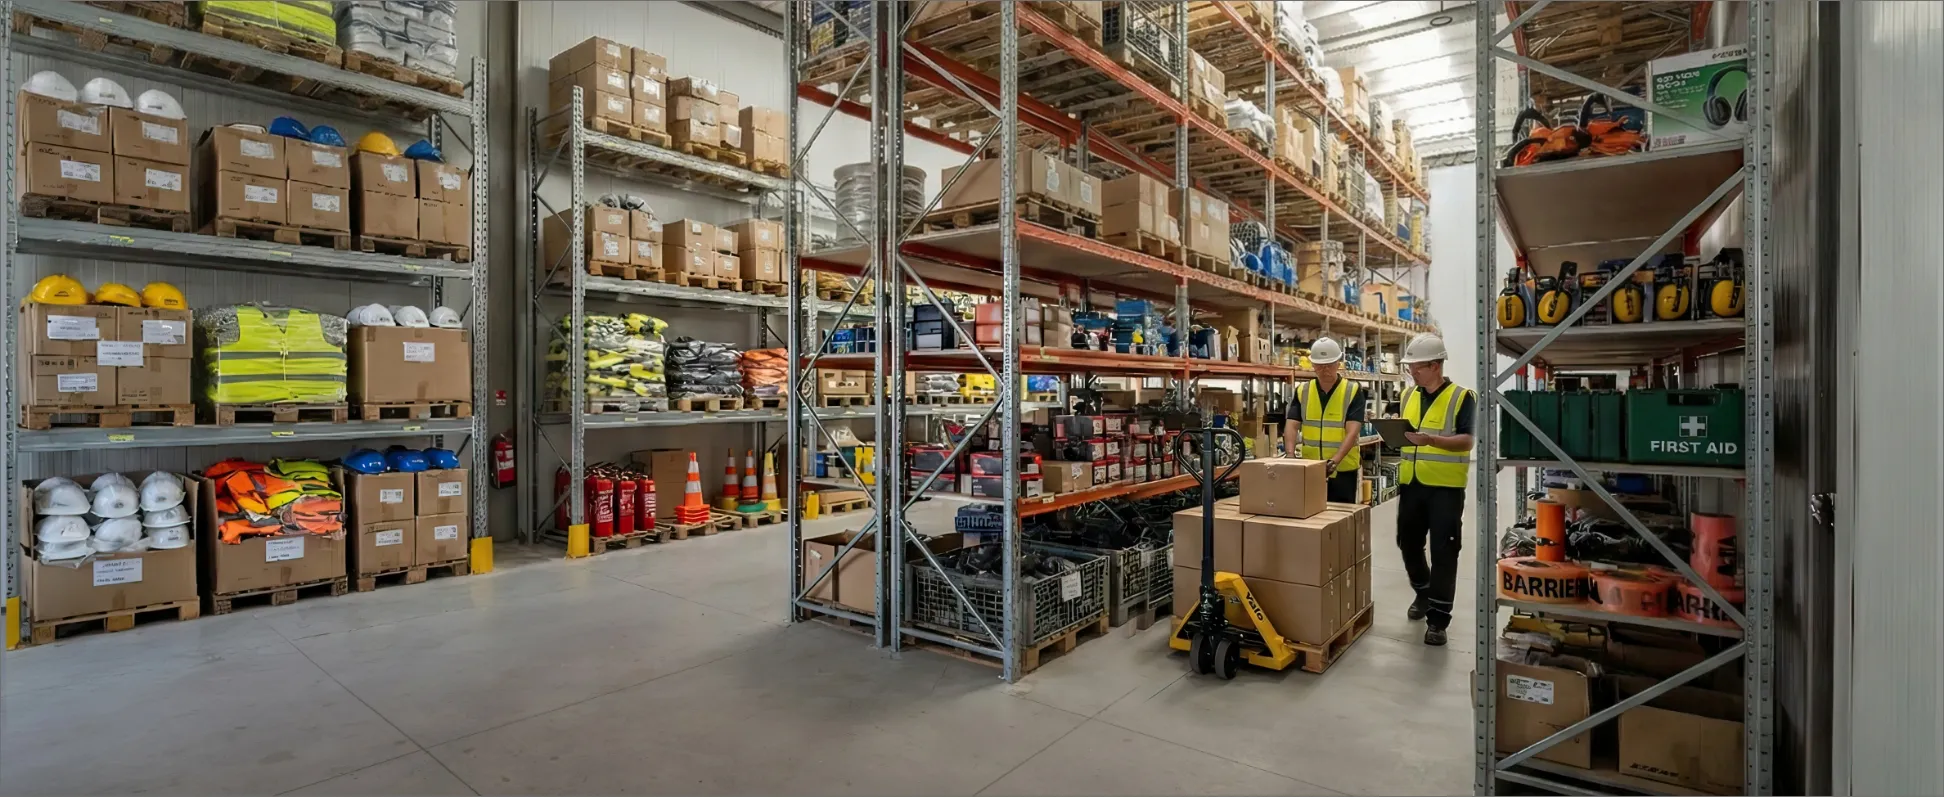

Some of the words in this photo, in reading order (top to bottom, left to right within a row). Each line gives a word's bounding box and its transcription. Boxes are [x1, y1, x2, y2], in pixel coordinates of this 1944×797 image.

[1650, 440, 1701, 454] FIRST
[1705, 442, 1738, 454] AID
[1246, 591, 1264, 621] Valo
